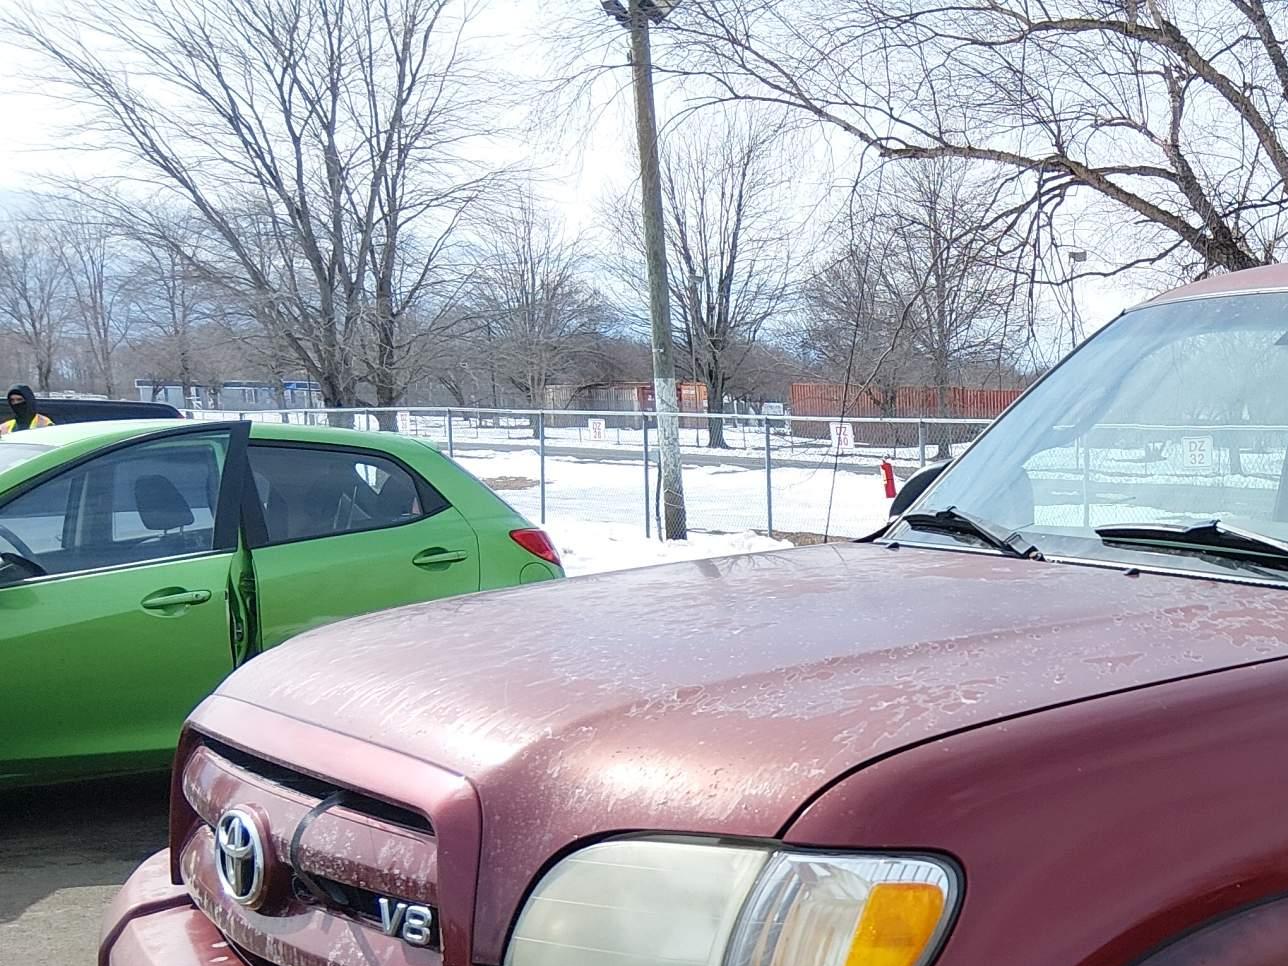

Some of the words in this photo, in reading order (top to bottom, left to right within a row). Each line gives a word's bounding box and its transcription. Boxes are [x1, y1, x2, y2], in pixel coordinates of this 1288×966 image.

[1188, 440, 1206, 453] DZ
[1189, 454, 1205, 465] 32
[377, 896, 432, 946] V8
